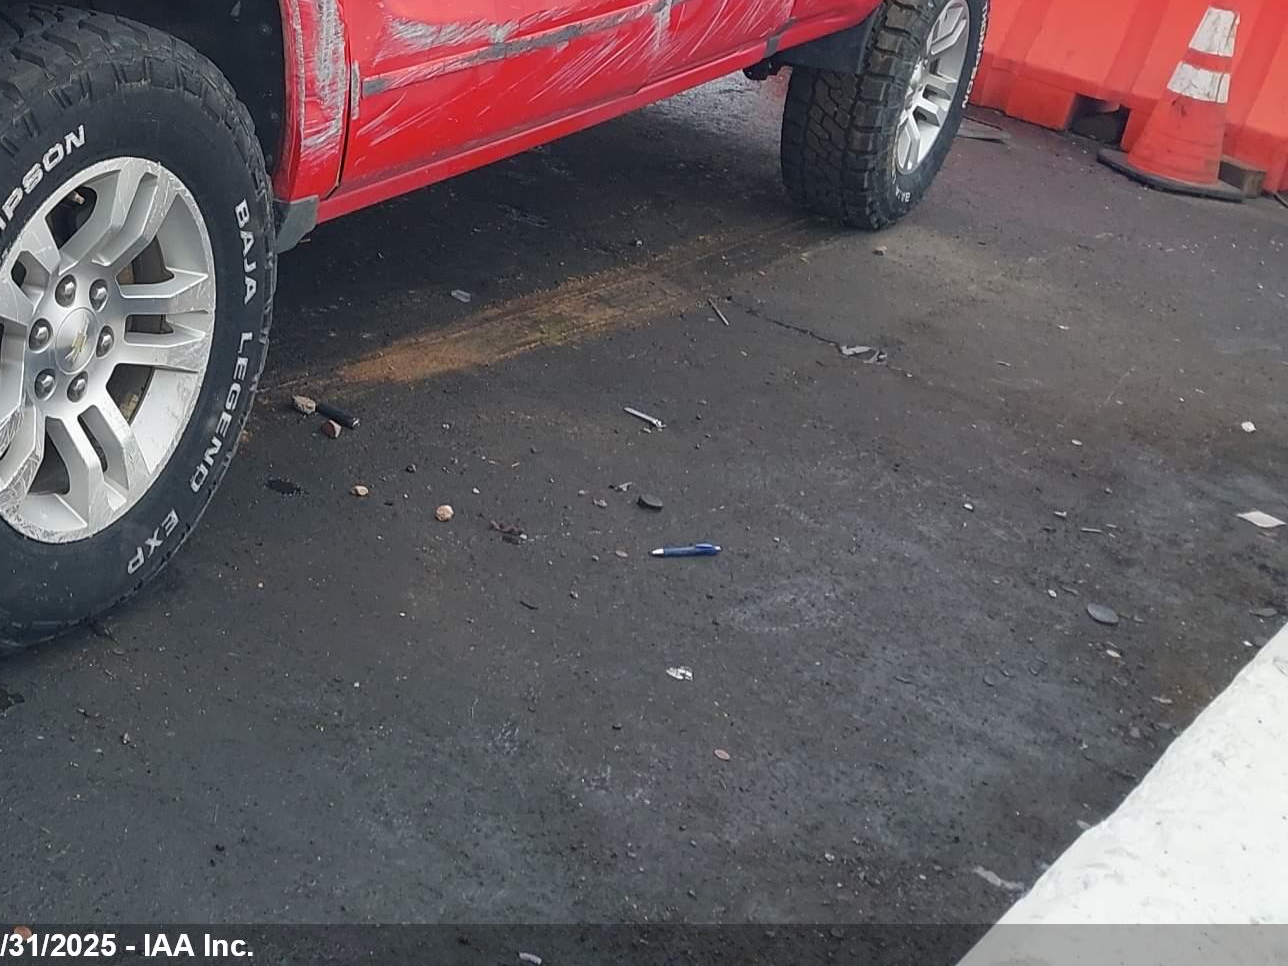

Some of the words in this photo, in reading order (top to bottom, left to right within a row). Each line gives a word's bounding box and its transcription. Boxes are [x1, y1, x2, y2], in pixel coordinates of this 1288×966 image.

[233, 199, 258, 305] BAJA
[189, 332, 253, 493] LEGEND
[127, 508, 178, 575] EXP
